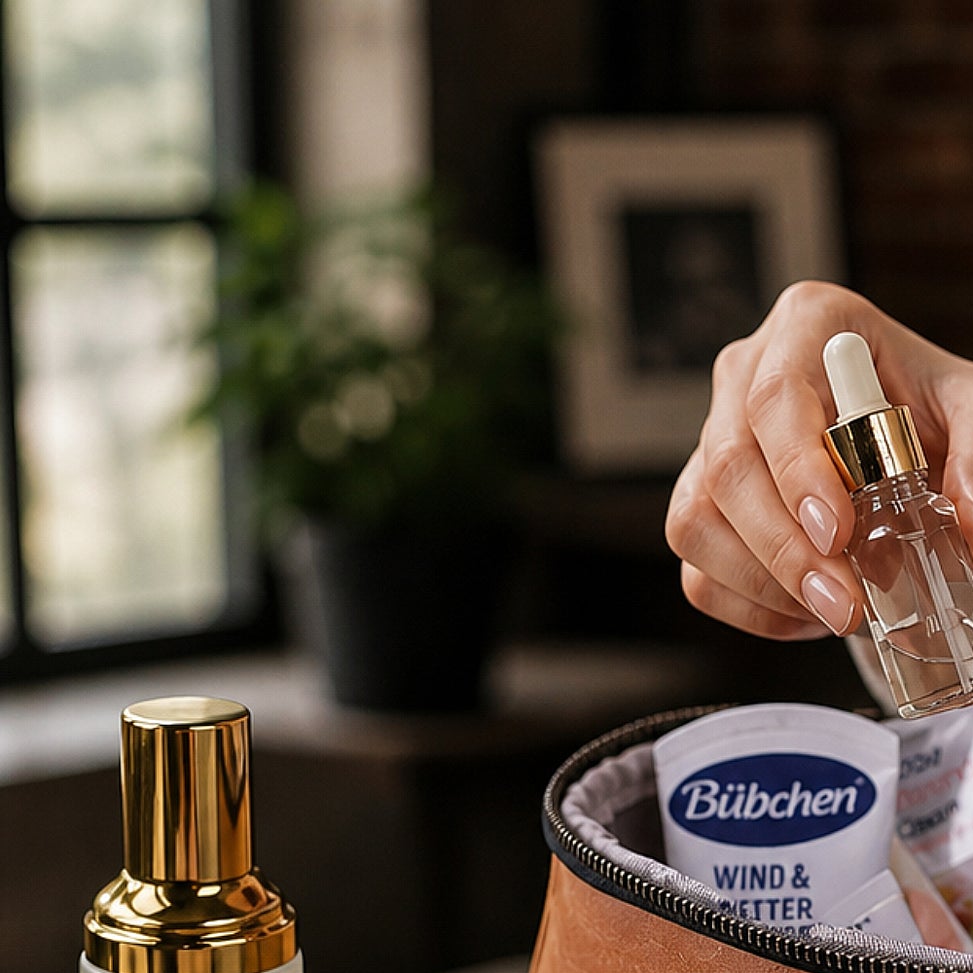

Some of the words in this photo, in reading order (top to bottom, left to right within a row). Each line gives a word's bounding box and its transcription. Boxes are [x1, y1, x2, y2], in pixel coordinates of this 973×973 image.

[681, 779, 858, 820] Bübchen
[713, 865, 785, 890] WIND
[791, 863, 810, 889] &
